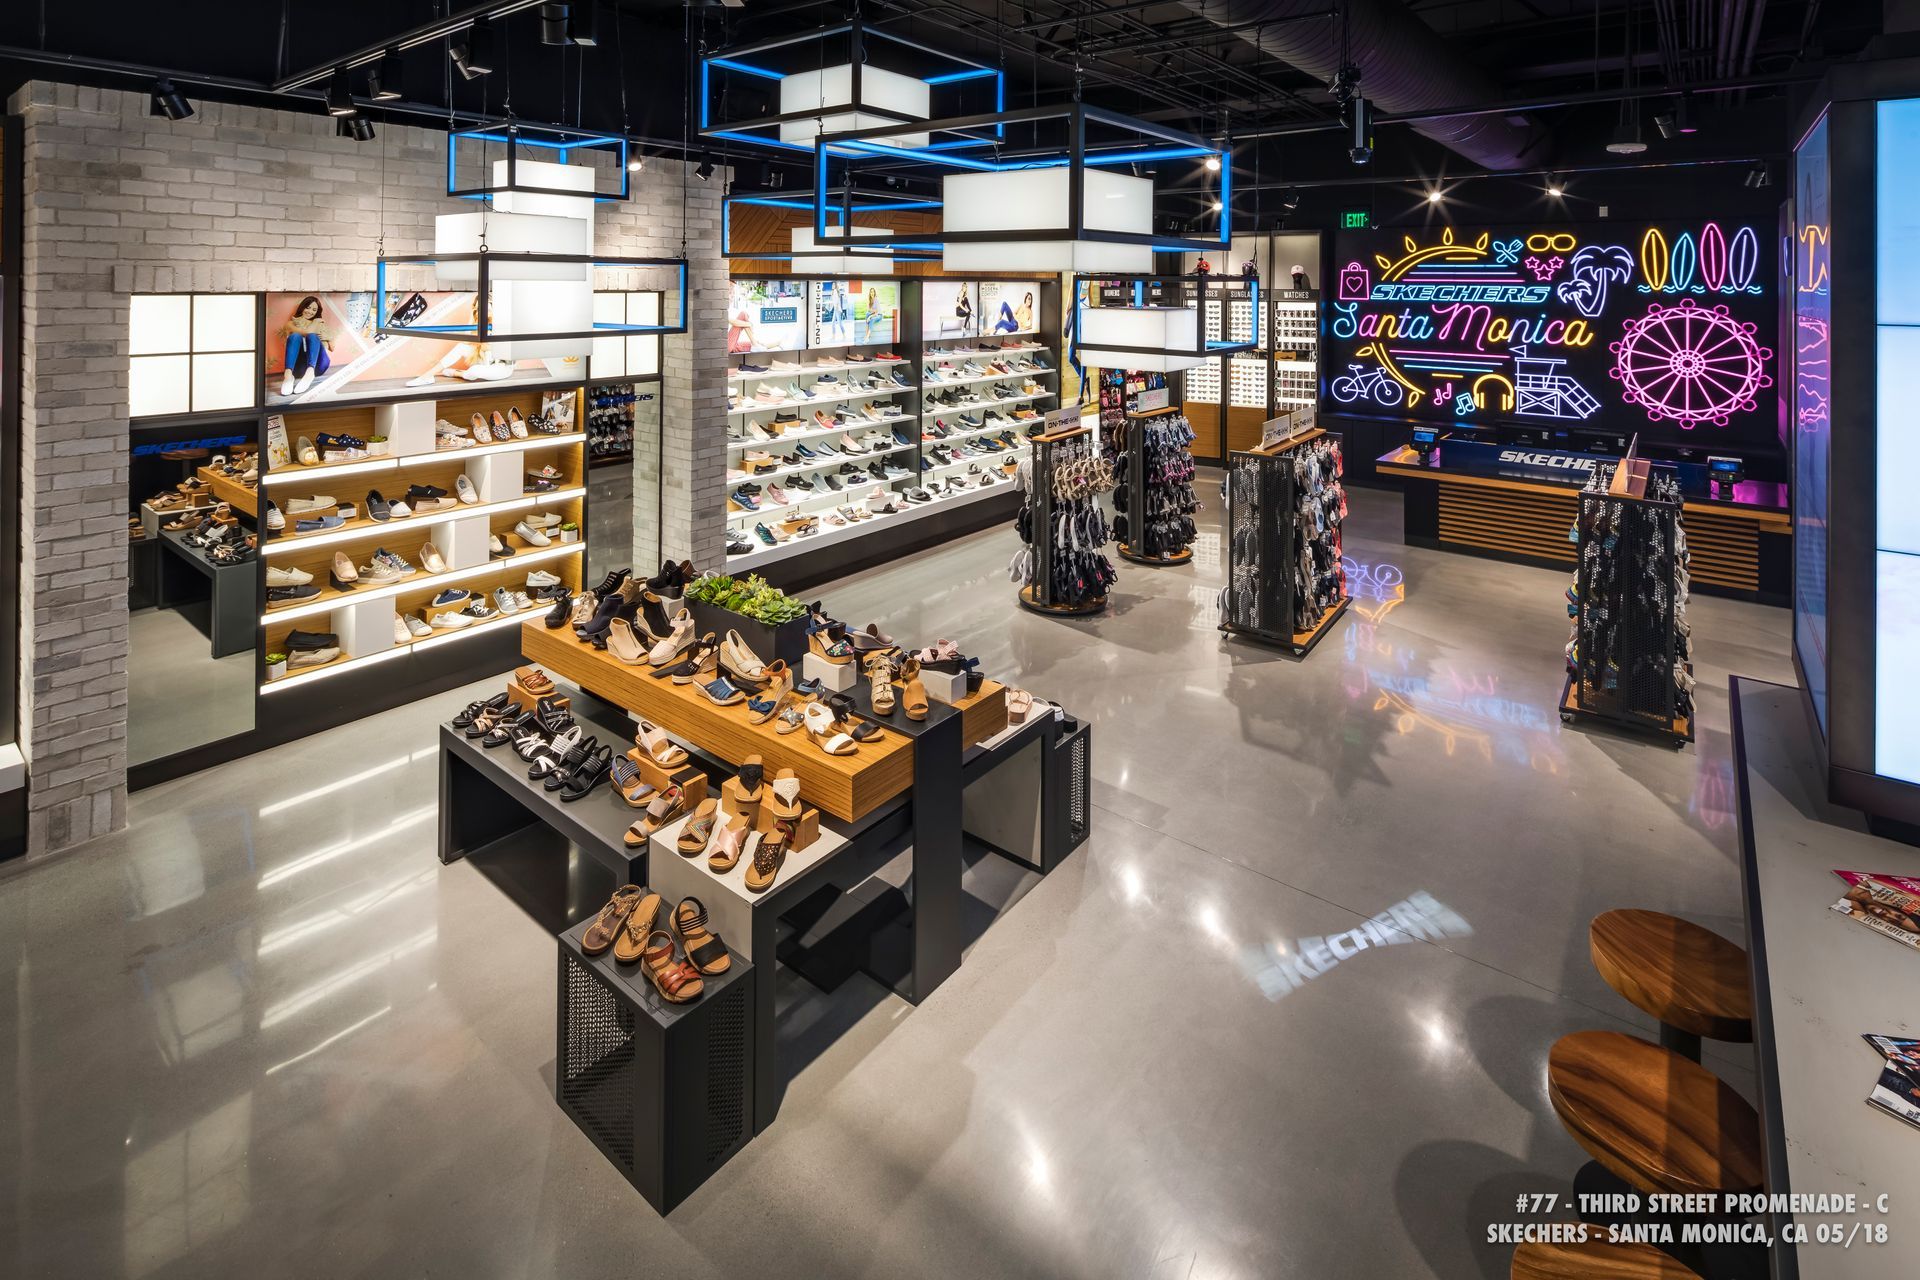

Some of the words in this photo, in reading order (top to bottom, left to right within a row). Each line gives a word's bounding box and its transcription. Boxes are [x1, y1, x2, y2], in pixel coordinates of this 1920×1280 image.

[1346, 213, 1366, 228] EXIT
[1186, 290, 1218, 298] SUNSSES
[1230, 290, 1264, 299] SUNGLAS
[1283, 291, 1310, 299] WATCHES
[1370, 284, 1551, 303] SKECHERS
[1333, 302, 1434, 340] Santa
[1432, 302, 1594, 351] Monica
[133, 435, 248, 457] SKECHERS
[1498, 450, 1597, 471] SKECHE
